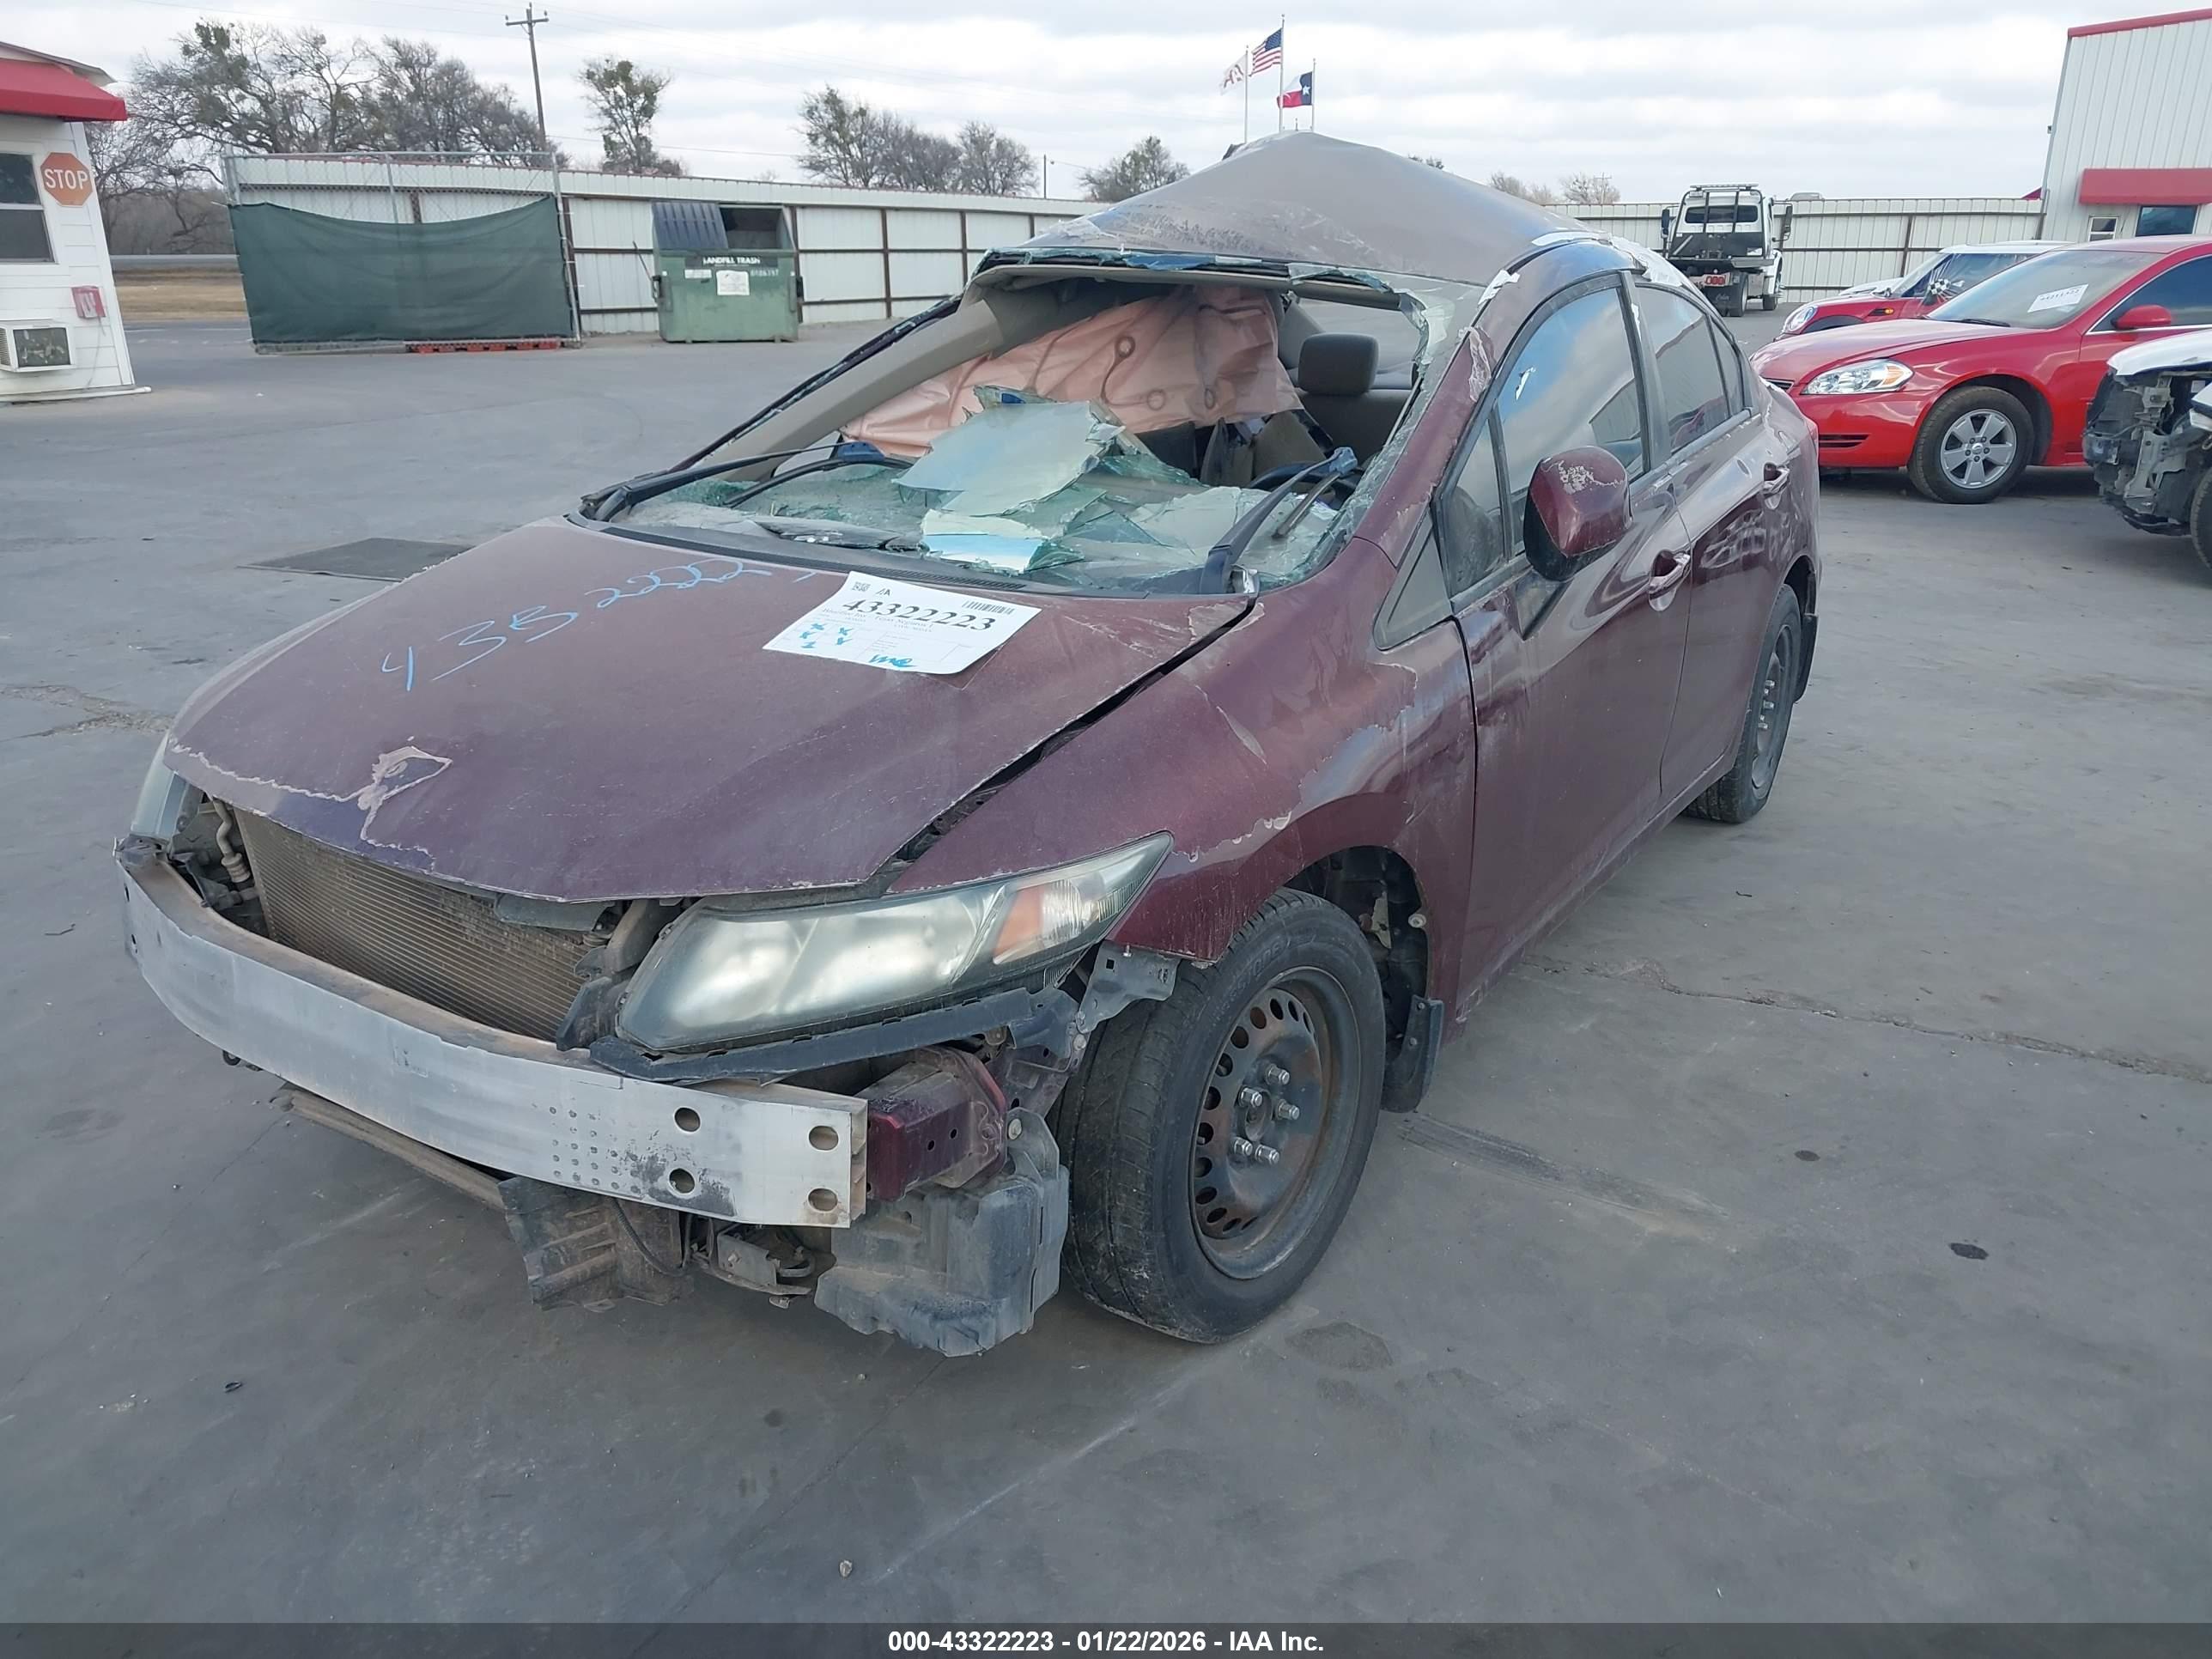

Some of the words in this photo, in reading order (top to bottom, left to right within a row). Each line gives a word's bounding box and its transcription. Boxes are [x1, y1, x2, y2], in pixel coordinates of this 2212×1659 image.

[44, 168, 88, 190] STOP
[702, 257, 735, 265] LANDFILL
[737, 256, 761, 265] TRASH
[842, 599, 996, 630] 43322223
